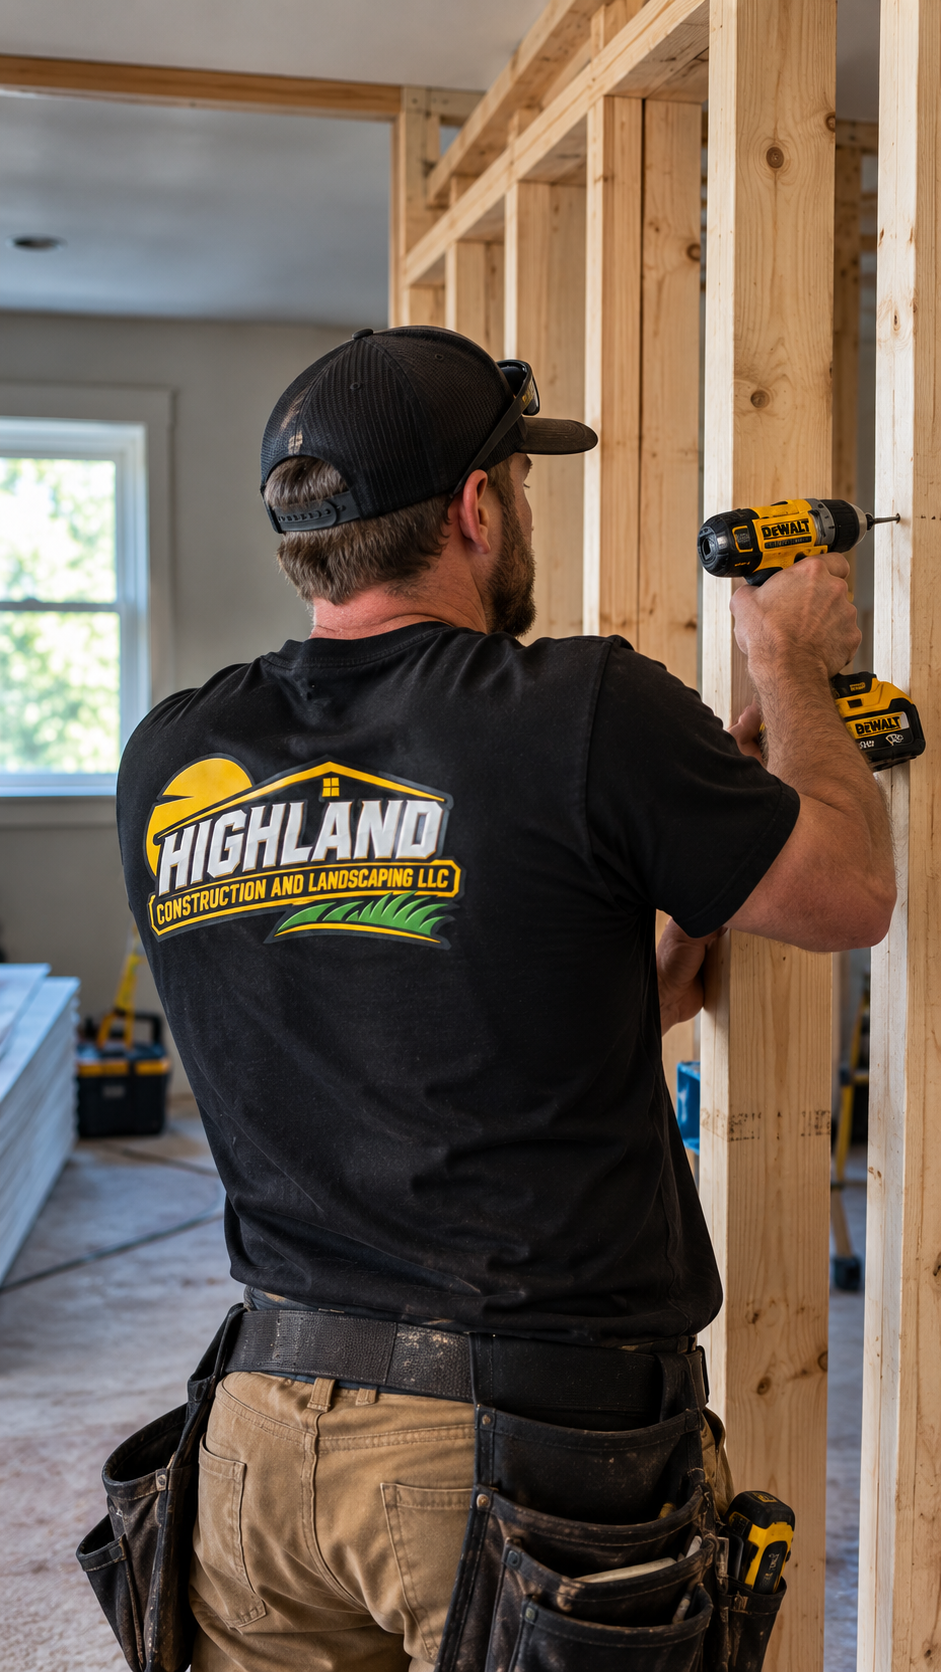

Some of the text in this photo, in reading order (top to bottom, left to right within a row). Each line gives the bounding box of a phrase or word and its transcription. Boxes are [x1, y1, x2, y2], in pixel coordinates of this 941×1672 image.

[159, 800, 444, 897] HIGHLAND
[156, 868, 449, 925] CONSTRUCTION AND LANDSCAPING LLC
